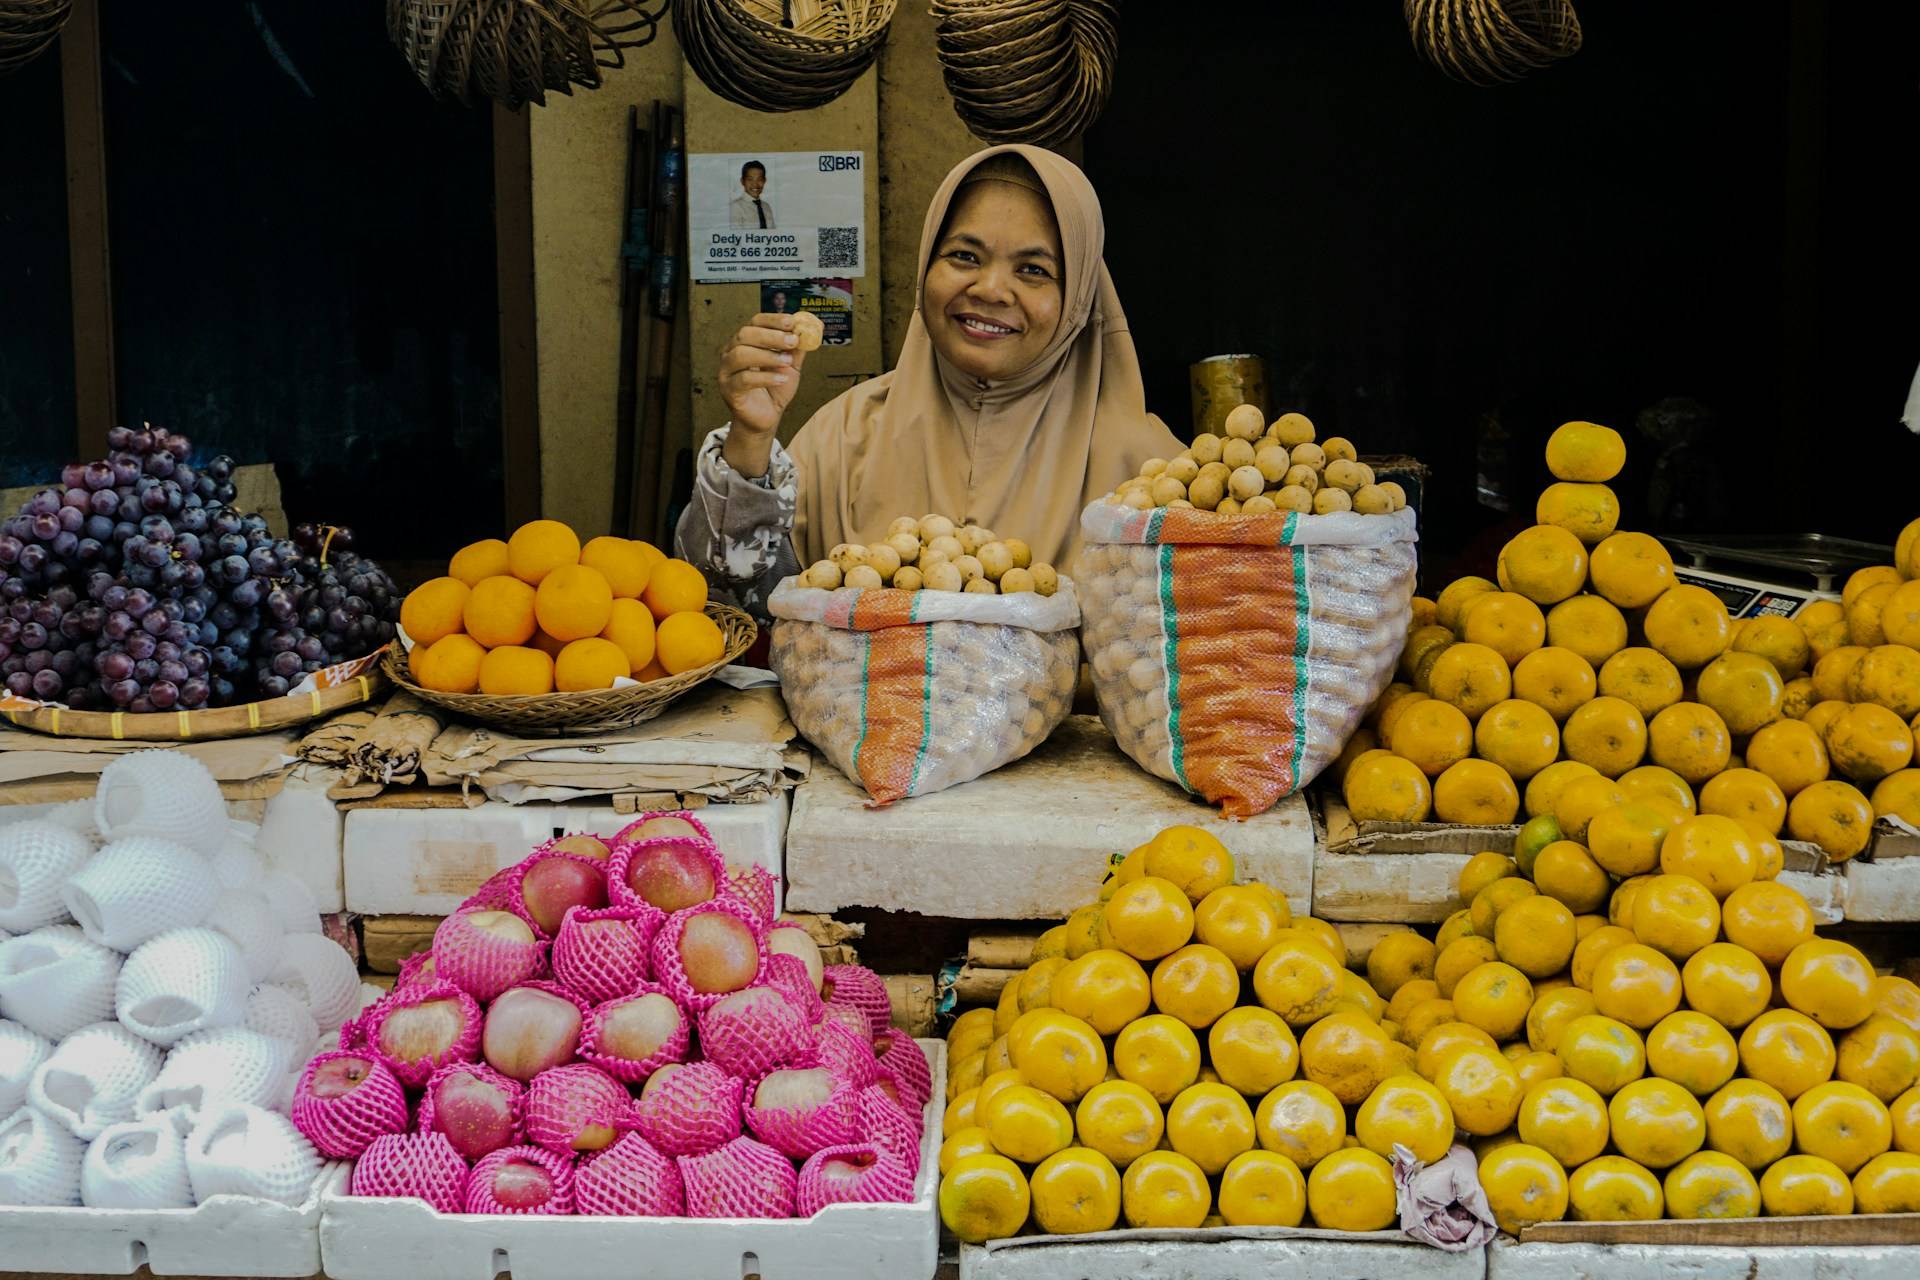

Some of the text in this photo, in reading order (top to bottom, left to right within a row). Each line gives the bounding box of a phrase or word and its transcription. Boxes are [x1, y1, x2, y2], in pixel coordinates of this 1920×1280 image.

[835, 156, 860, 170] BRI
[712, 233, 795, 246] Dedy Haryono
[709, 246, 798, 258] 0852 666 20202
